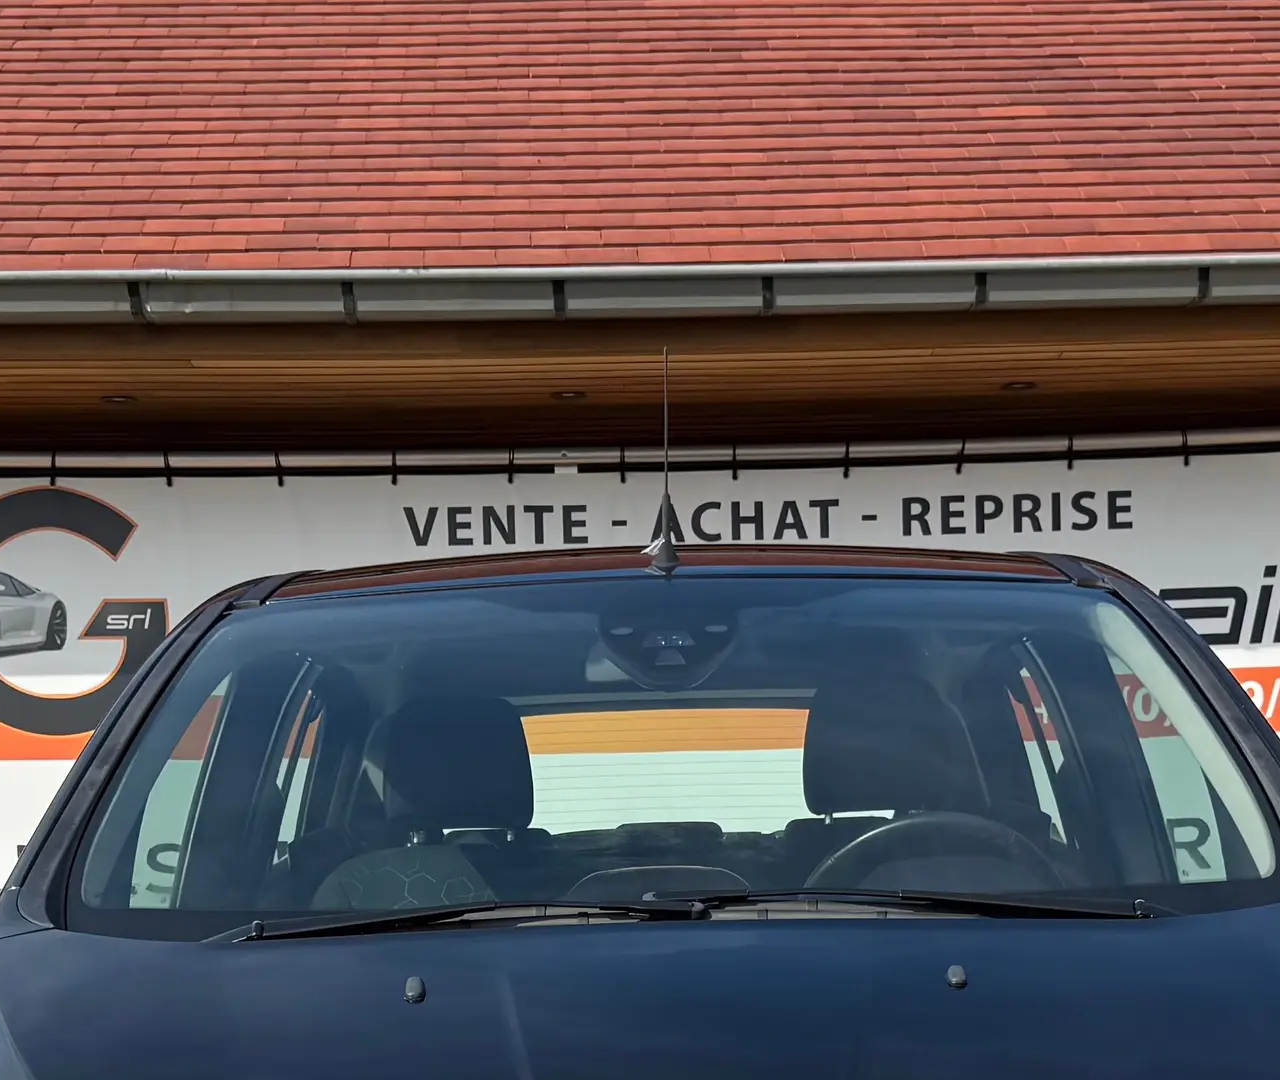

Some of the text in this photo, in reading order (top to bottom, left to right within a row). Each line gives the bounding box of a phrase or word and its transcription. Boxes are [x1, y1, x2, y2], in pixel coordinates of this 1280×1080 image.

[403, 505, 589, 546] VENTE
[651, 498, 840, 543] ACHAT
[902, 490, 1133, 536] REPRISE
[105, 608, 152, 630] srl
